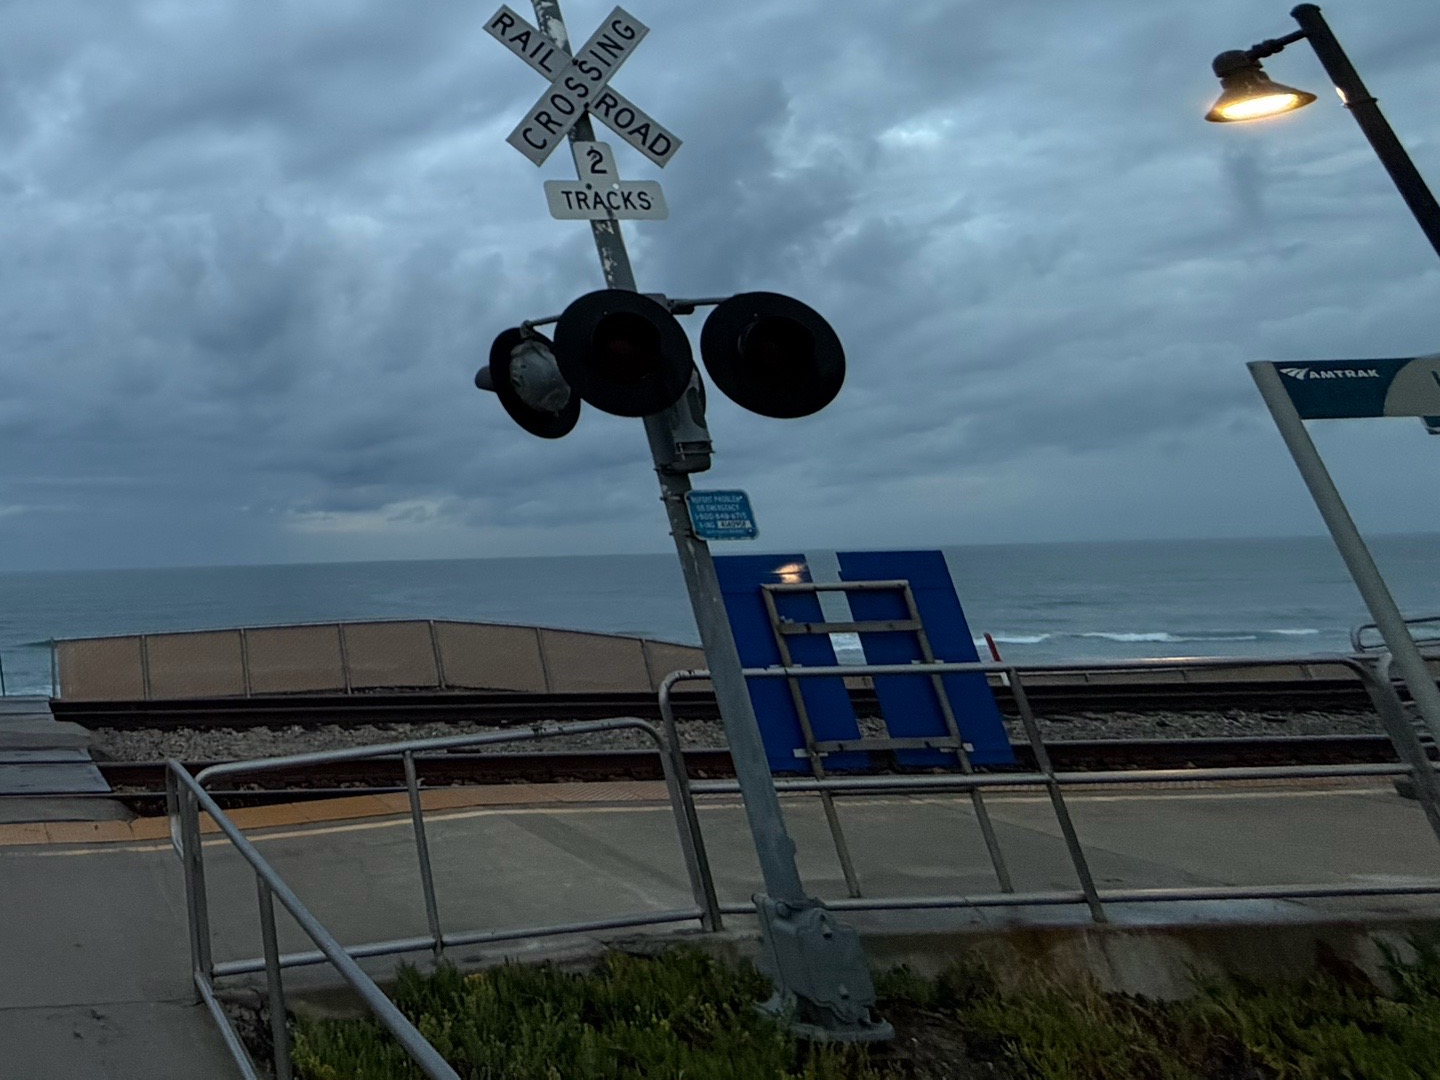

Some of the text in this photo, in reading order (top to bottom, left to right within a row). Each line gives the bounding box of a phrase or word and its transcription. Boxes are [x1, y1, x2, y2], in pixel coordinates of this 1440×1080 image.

[491, 12, 672, 157] RAIL ROAD
[522, 19, 636, 150] CROSSING
[586, 147, 608, 175] 2
[560, 189, 653, 211] TRACKS
[1309, 368, 1380, 379] AMTRAK
